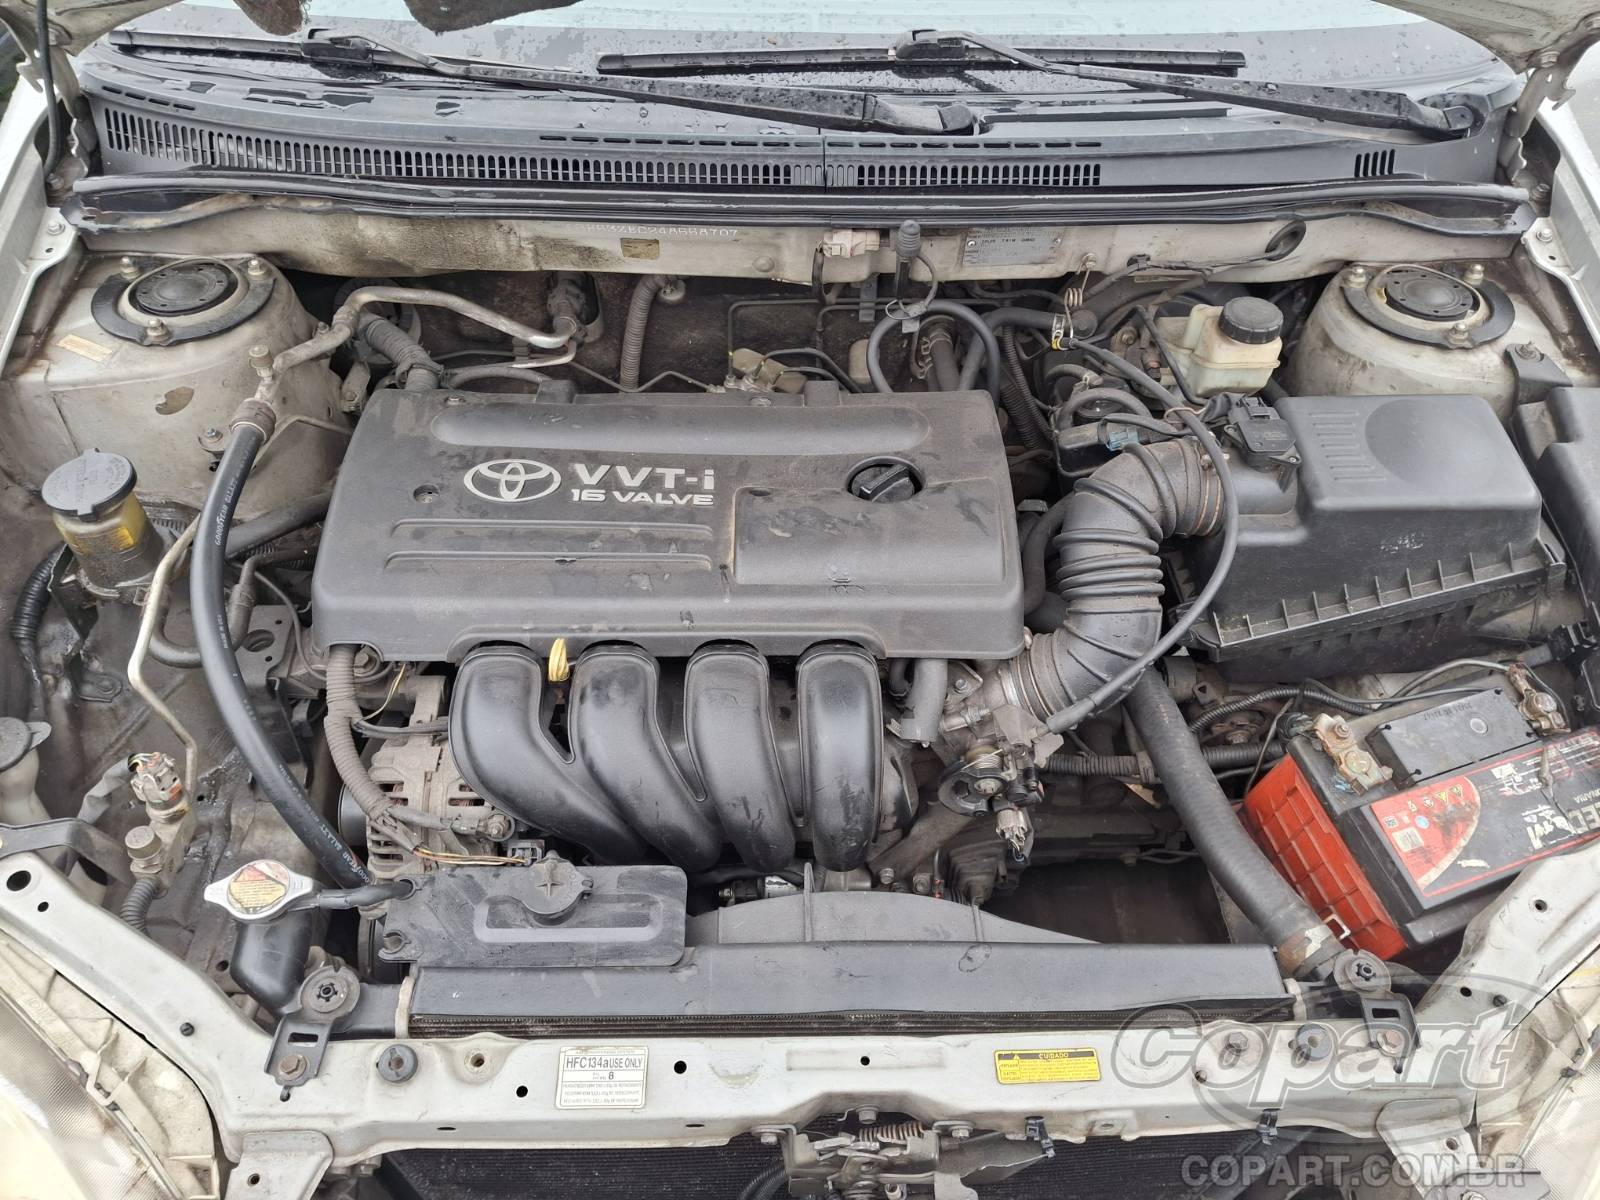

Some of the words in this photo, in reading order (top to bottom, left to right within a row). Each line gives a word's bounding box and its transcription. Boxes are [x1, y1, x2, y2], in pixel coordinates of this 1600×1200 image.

[573, 463, 715, 490] VVT-i
[570, 488, 606, 502] 16
[612, 490, 715, 506] VALVE
[1038, 1052, 1069, 1060] CUIDADO
[609, 1057, 623, 1068] USE
[624, 1057, 643, 1068] ONLY
[608, 1071, 614, 1080] 8
